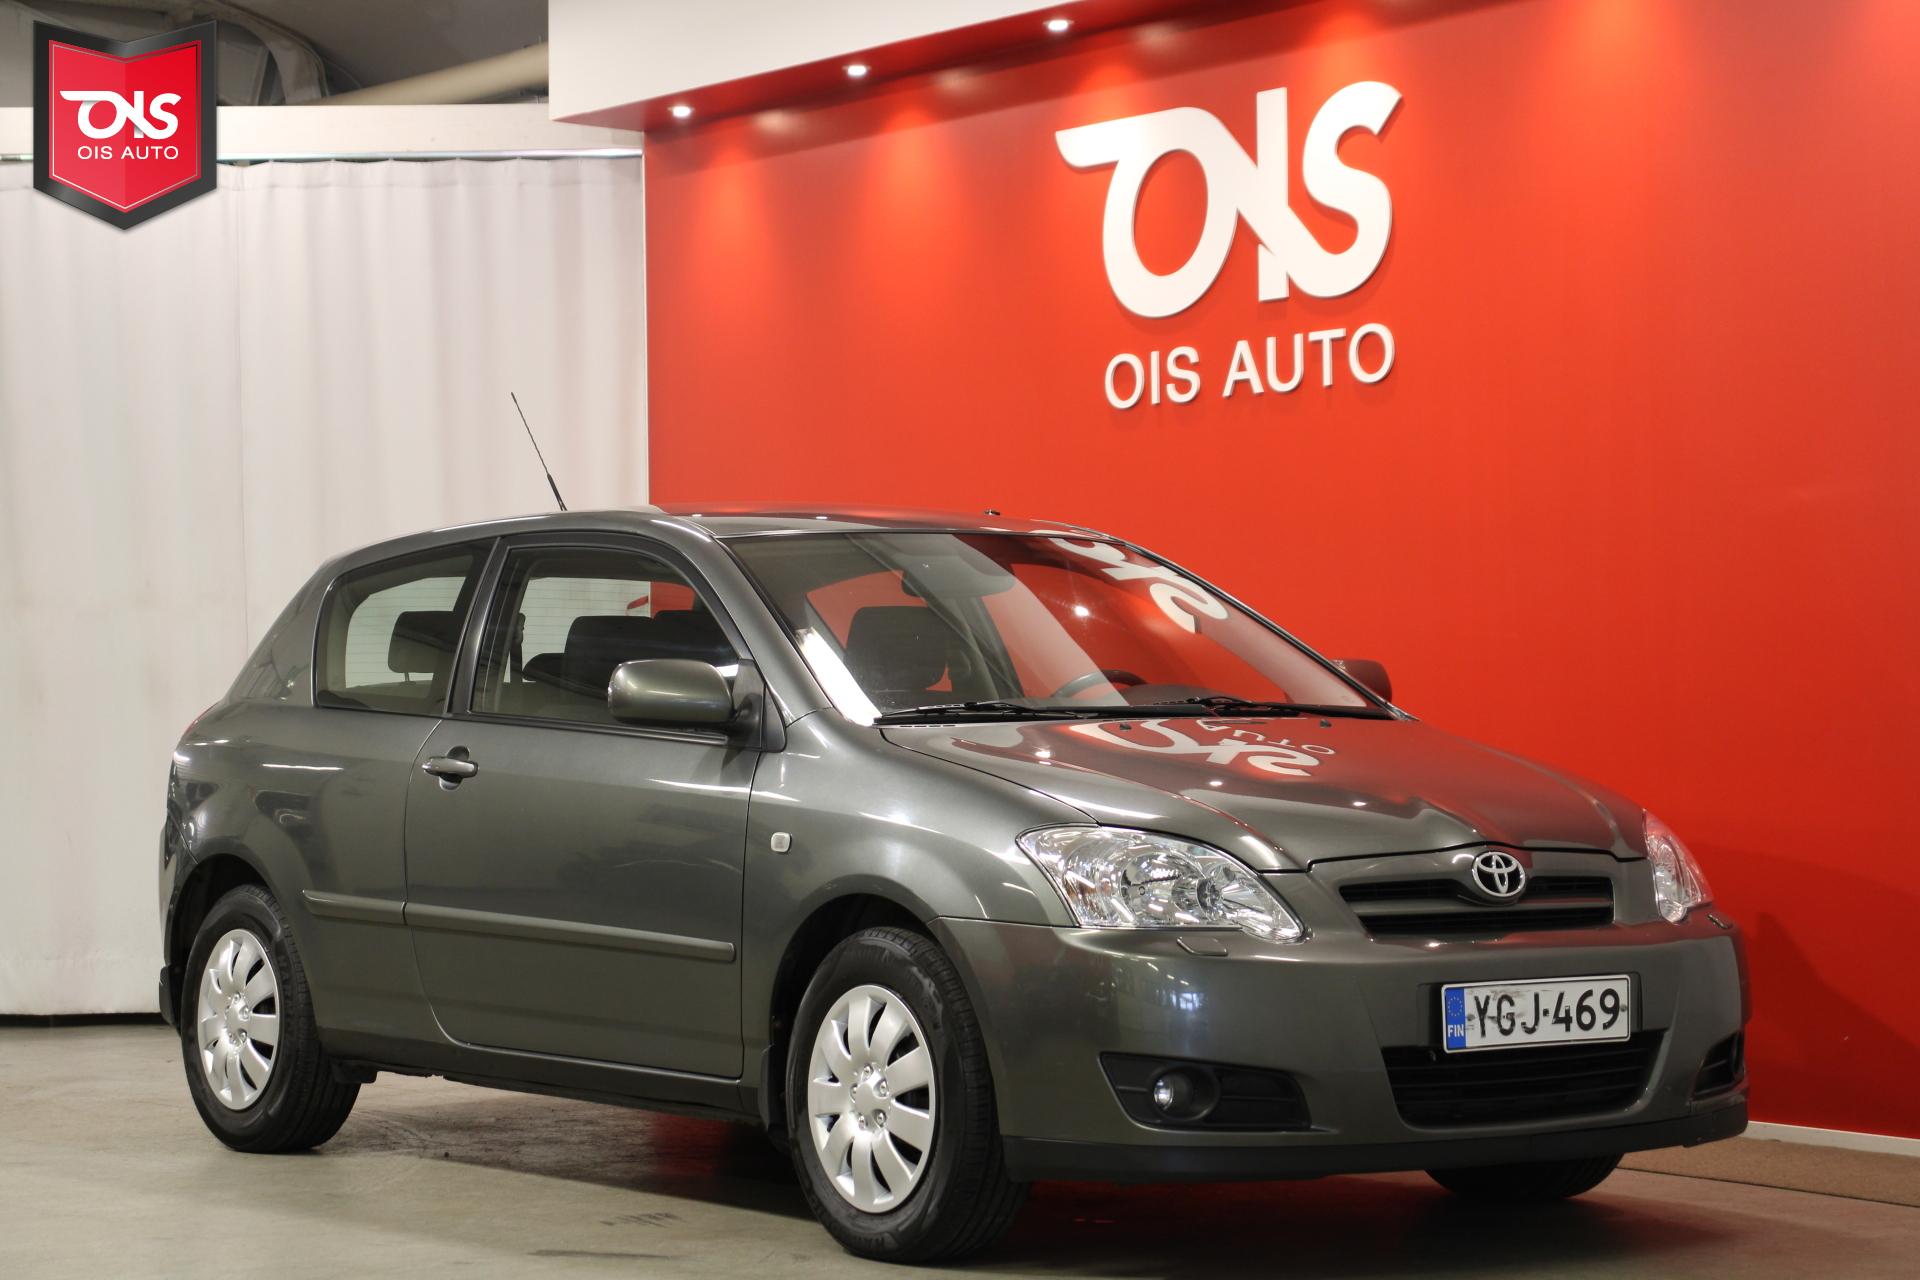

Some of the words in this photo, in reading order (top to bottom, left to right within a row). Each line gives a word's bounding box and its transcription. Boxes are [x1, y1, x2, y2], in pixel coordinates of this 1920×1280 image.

[1104, 346, 1201, 409] OIS
[1222, 323, 1396, 398] AUTO
[1447, 1023, 1465, 1037] FIN
